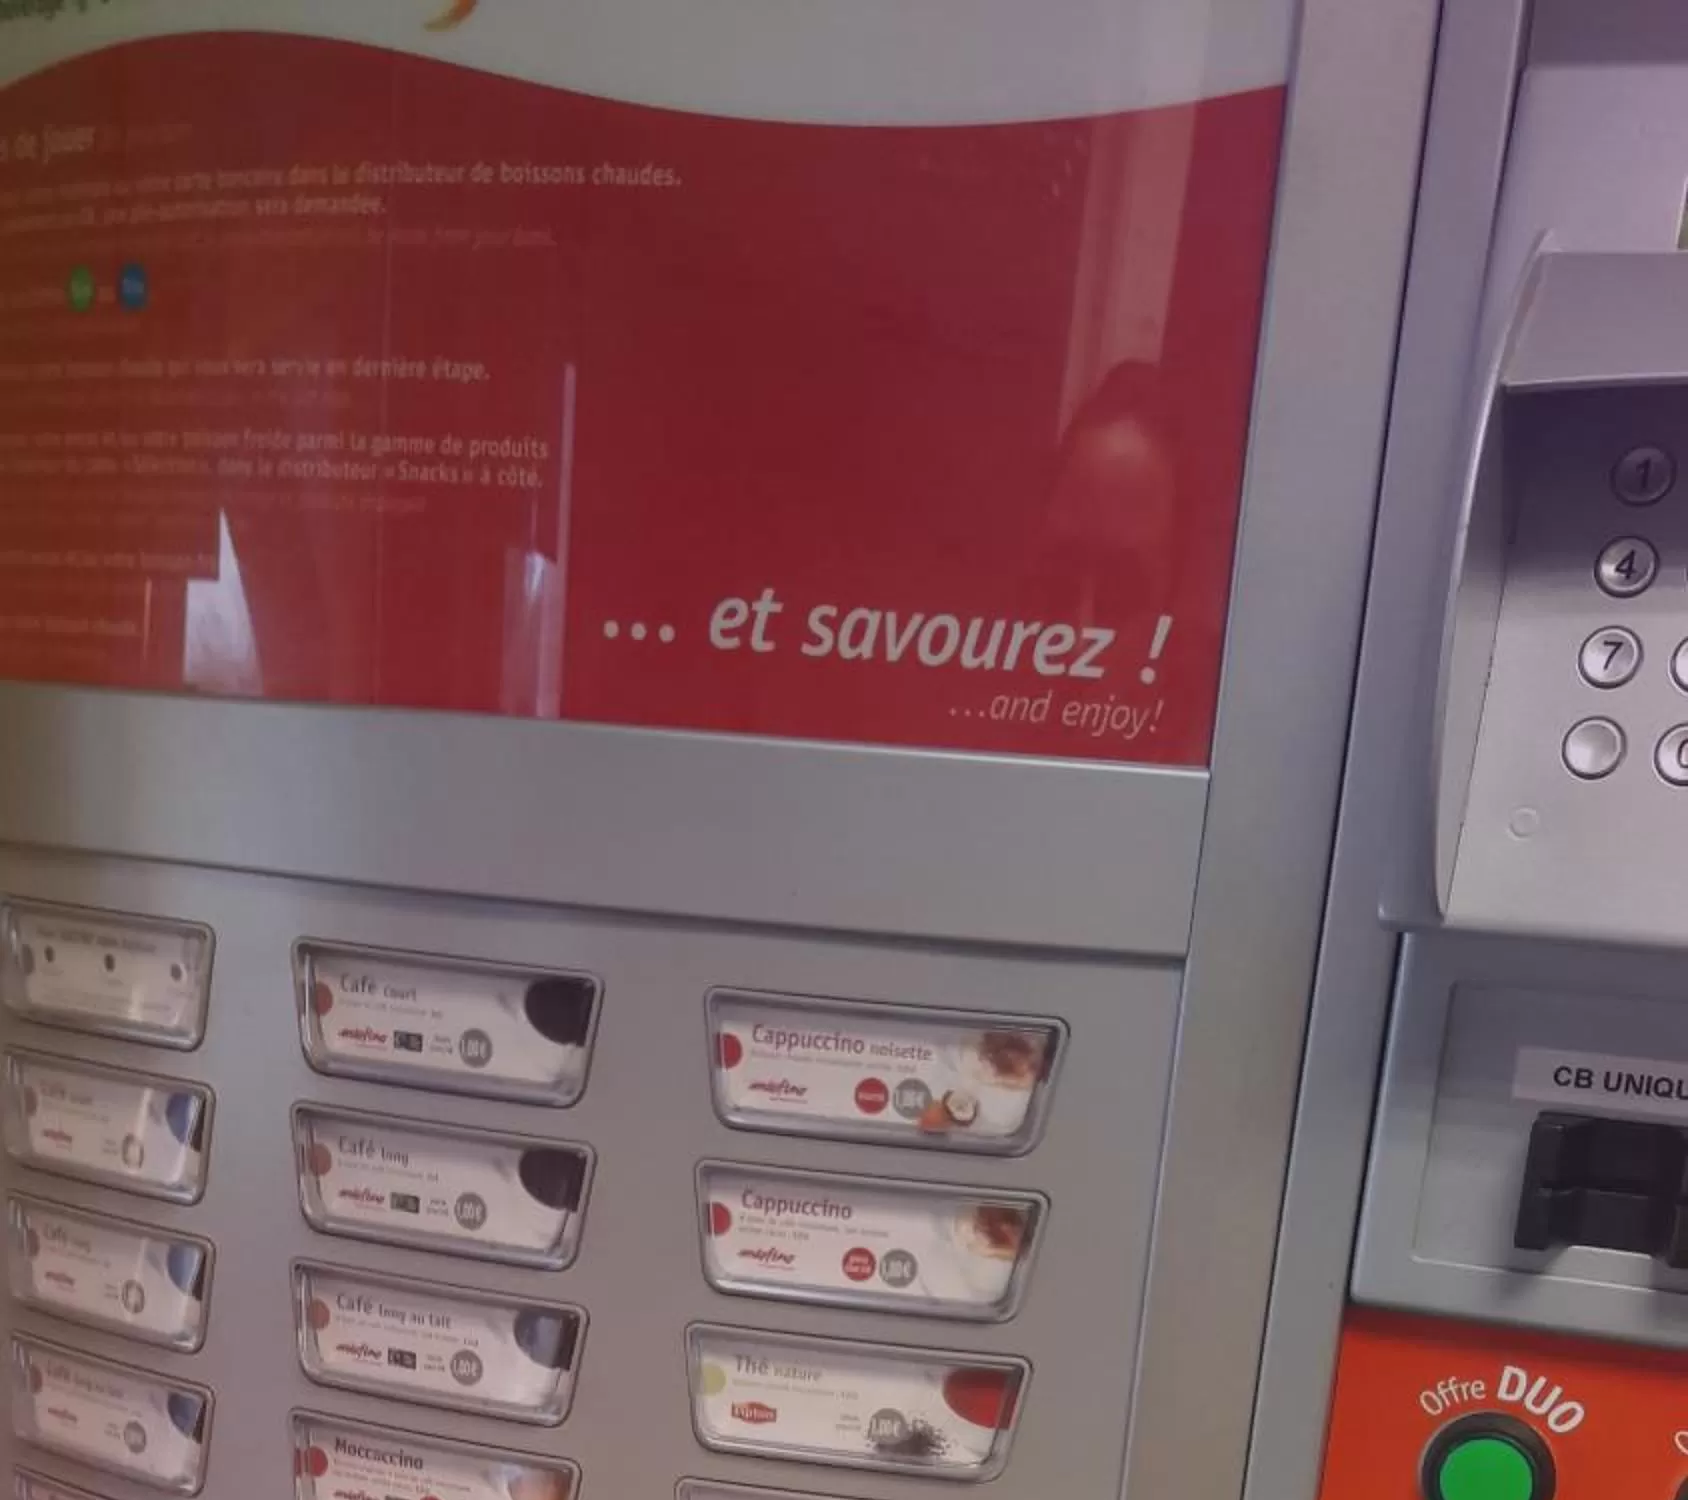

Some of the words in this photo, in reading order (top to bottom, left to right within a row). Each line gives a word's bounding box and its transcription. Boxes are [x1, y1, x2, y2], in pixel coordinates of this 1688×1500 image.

[354, 159, 466, 185] distributeur
[470, 160, 496, 184] de
[500, 159, 587, 186] boissons
[592, 160, 683, 187] chaudes.
[352, 352, 428, 381] dernière
[431, 351, 493, 384] étape.
[371, 432, 437, 457] gamme
[440, 430, 464, 458] de
[469, 431, 549, 464] produits
[1636, 457, 1652, 491] 1
[1613, 548, 1638, 581] 4
[708, 588, 783, 653] et
[801, 602, 1116, 679] savourez
[1601, 641, 1624, 671] 7
[1060, 696, 1165, 738] enjoy!
[339, 972, 376, 996] Café
[751, 1023, 865, 1056] Cappuccino
[868, 1043, 935, 1063] noisette
[1553, 1065, 1594, 1090] CB
[339, 1135, 375, 1155] Café
[380, 1145, 410, 1167] long
[740, 1189, 853, 1222] Cappuccino
[336, 1294, 373, 1315] Café
[378, 1302, 406, 1322] long
[408, 1312, 426, 1326] au
[428, 1311, 451, 1329] lait
[735, 1353, 769, 1377] Thé
[773, 1366, 823, 1383] nature
[1418, 1376, 1486, 1416] Offre
[1496, 1364, 1585, 1434] DUO
[333, 1436, 424, 1471] Moccaccino
